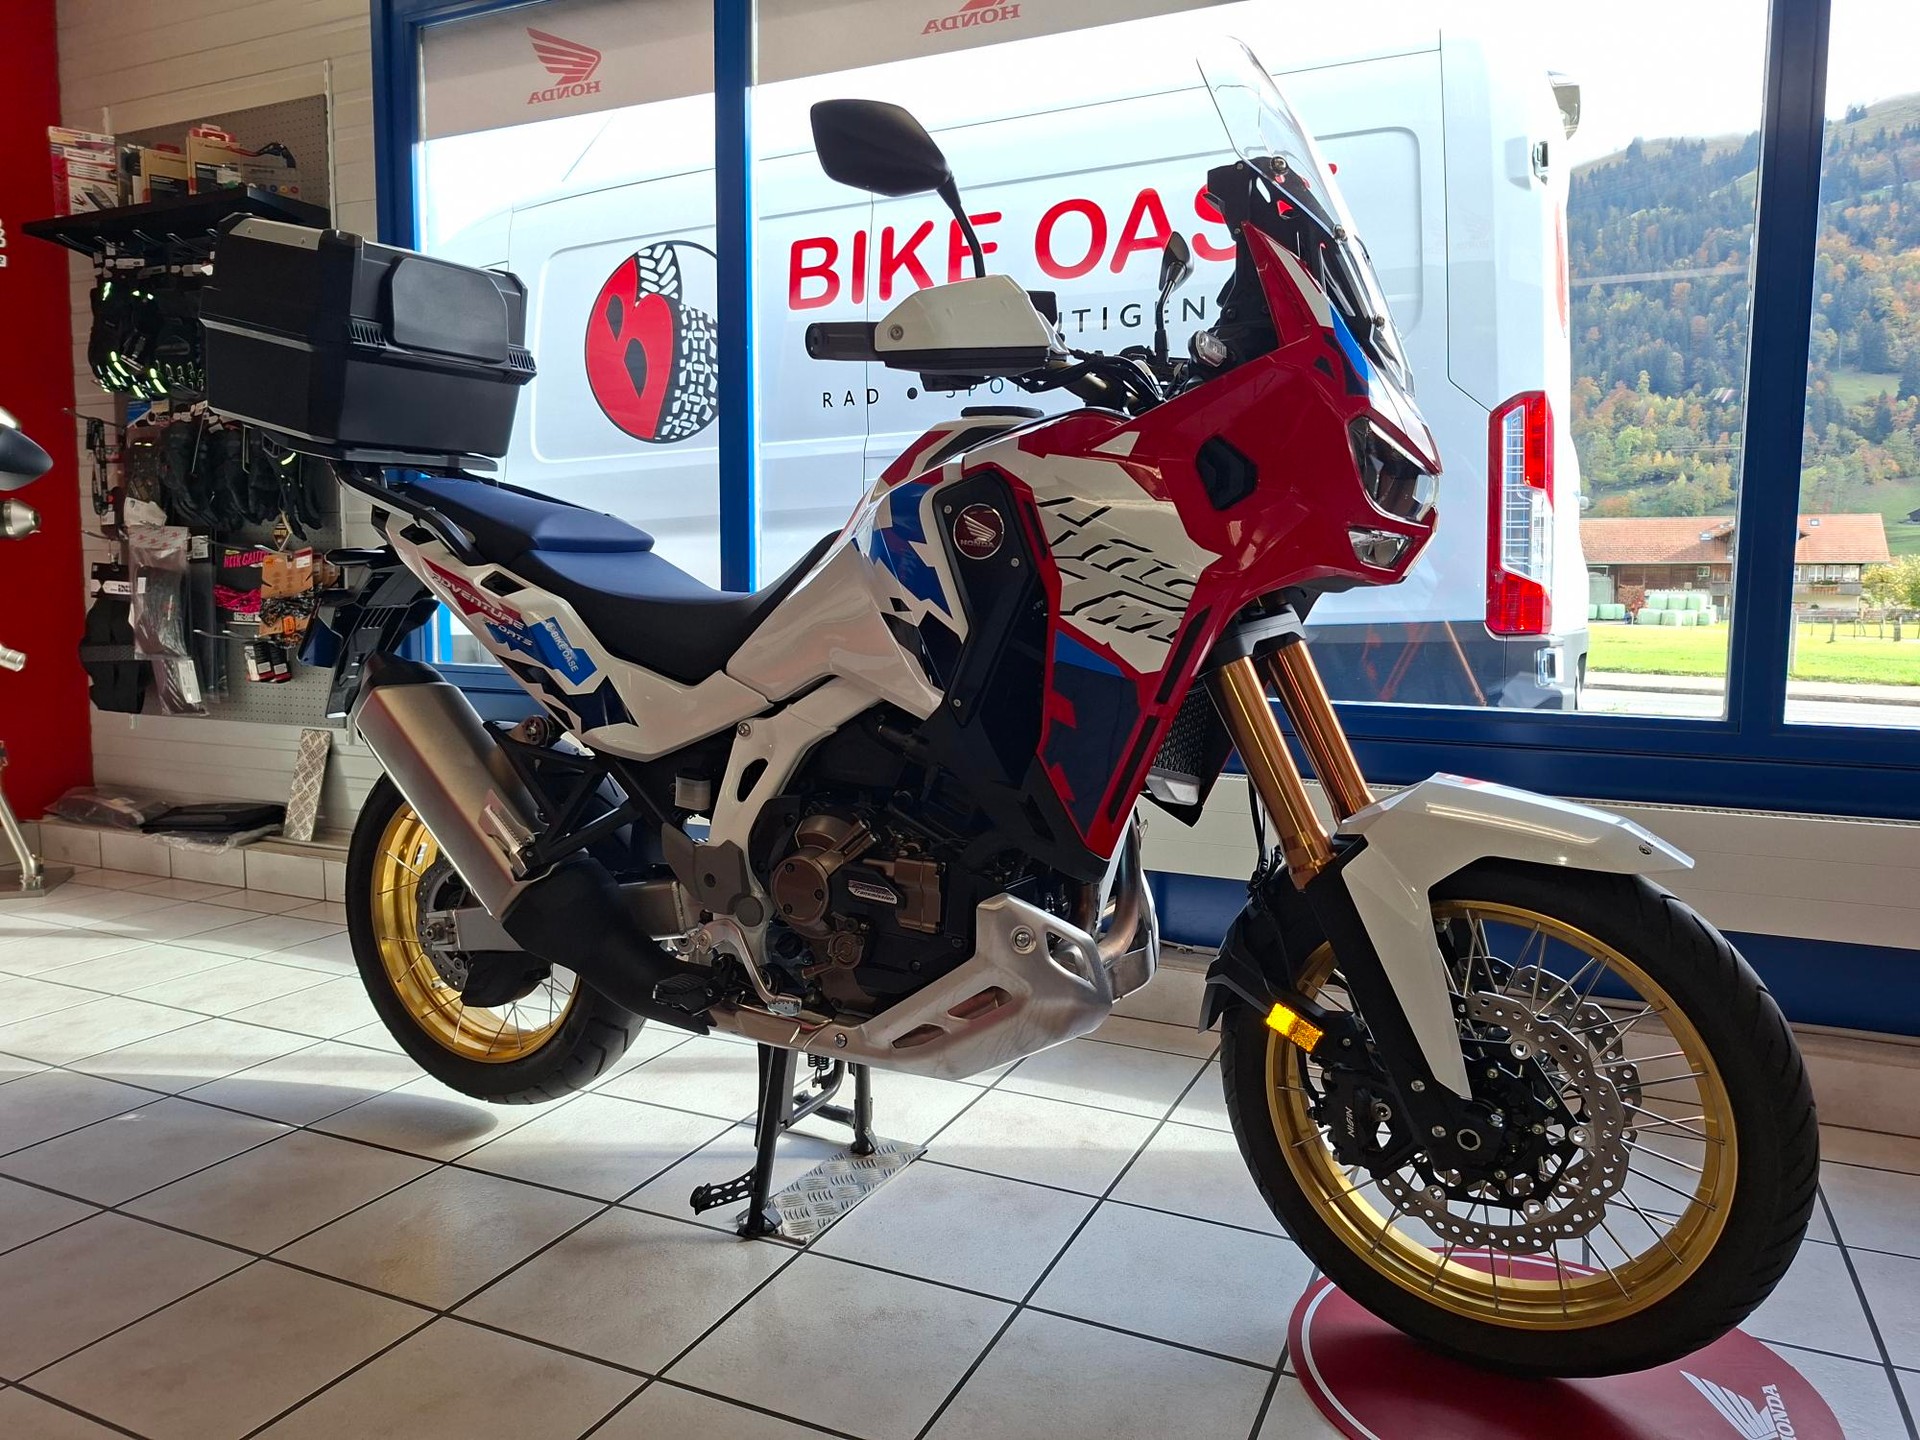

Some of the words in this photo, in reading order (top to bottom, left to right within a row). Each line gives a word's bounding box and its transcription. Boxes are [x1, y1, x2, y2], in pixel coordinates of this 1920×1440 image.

[788, 211, 1002, 311] BIKE
[1057, 296, 1206, 333] TIGEN
[822, 388, 879, 408] RAD
[960, 539, 996, 548] HONDA
[431, 572, 526, 631] ADVENTURE
